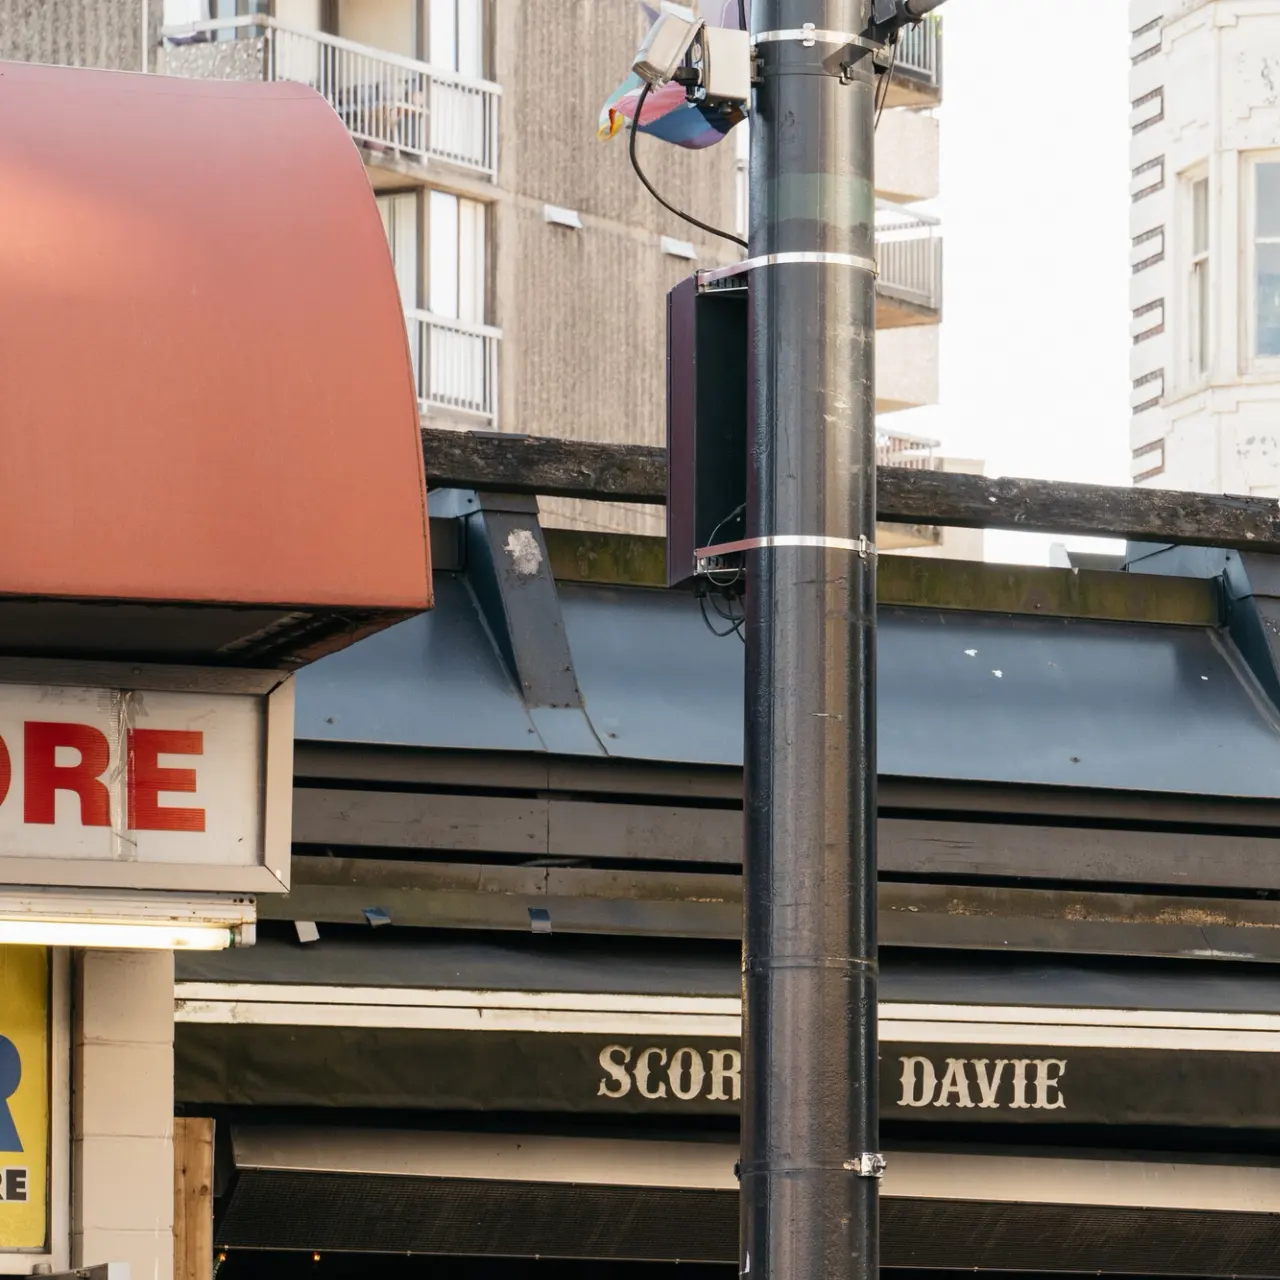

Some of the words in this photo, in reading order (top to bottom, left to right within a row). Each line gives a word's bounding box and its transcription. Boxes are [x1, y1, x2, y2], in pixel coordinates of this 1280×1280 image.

[0, 719, 206, 832] RE
[597, 1043, 742, 1101] SCOR
[897, 1055, 1068, 1110] DAVIE
[0, 1169, 27, 1200] E
